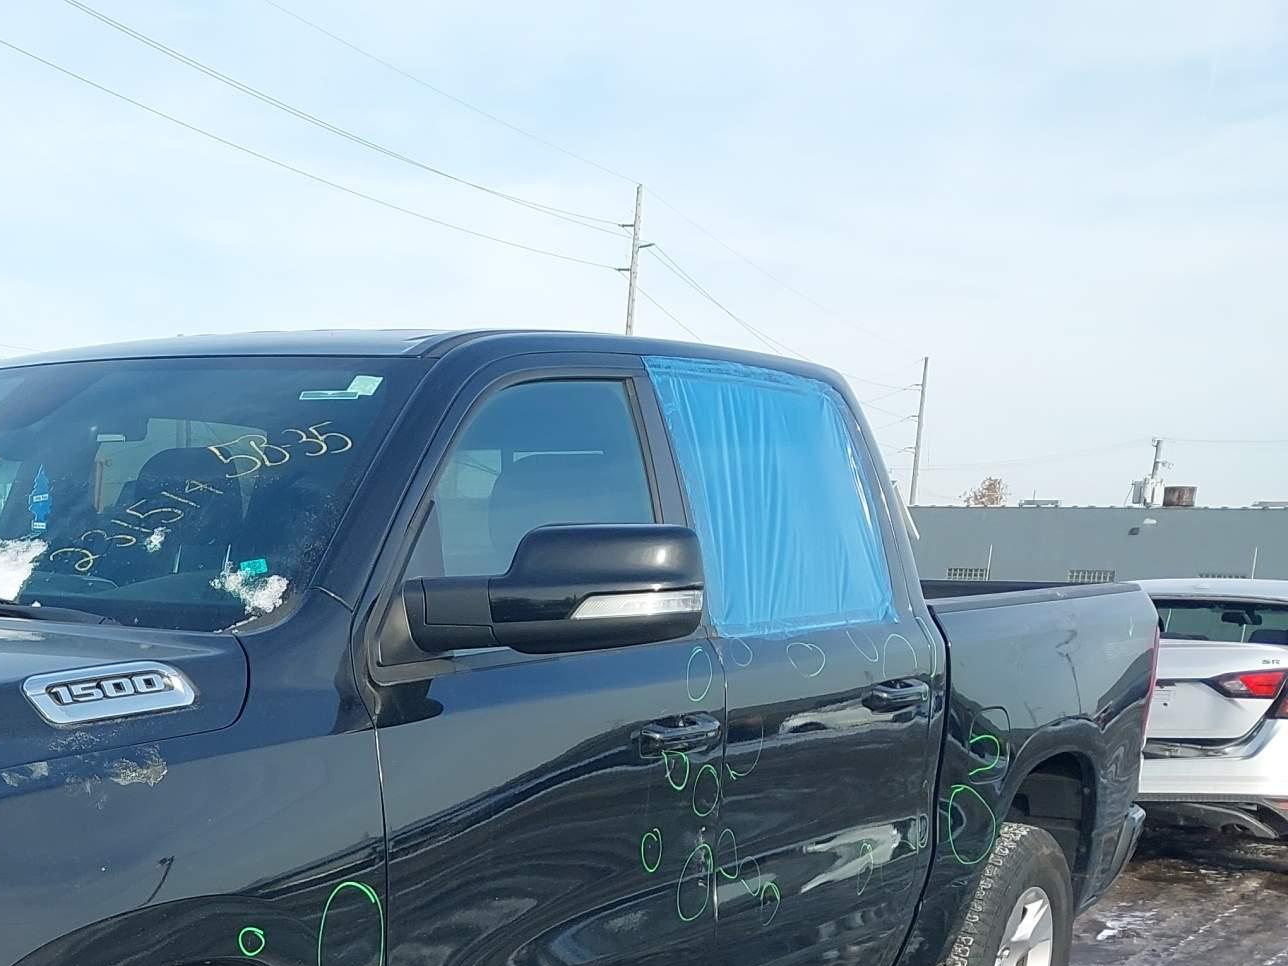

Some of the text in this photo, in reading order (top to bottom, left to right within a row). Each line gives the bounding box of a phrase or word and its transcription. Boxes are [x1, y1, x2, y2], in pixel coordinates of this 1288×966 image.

[207, 420, 353, 478] 5B-35
[1261, 658, 1281, 666] SR
[50, 672, 165, 704] 1500
